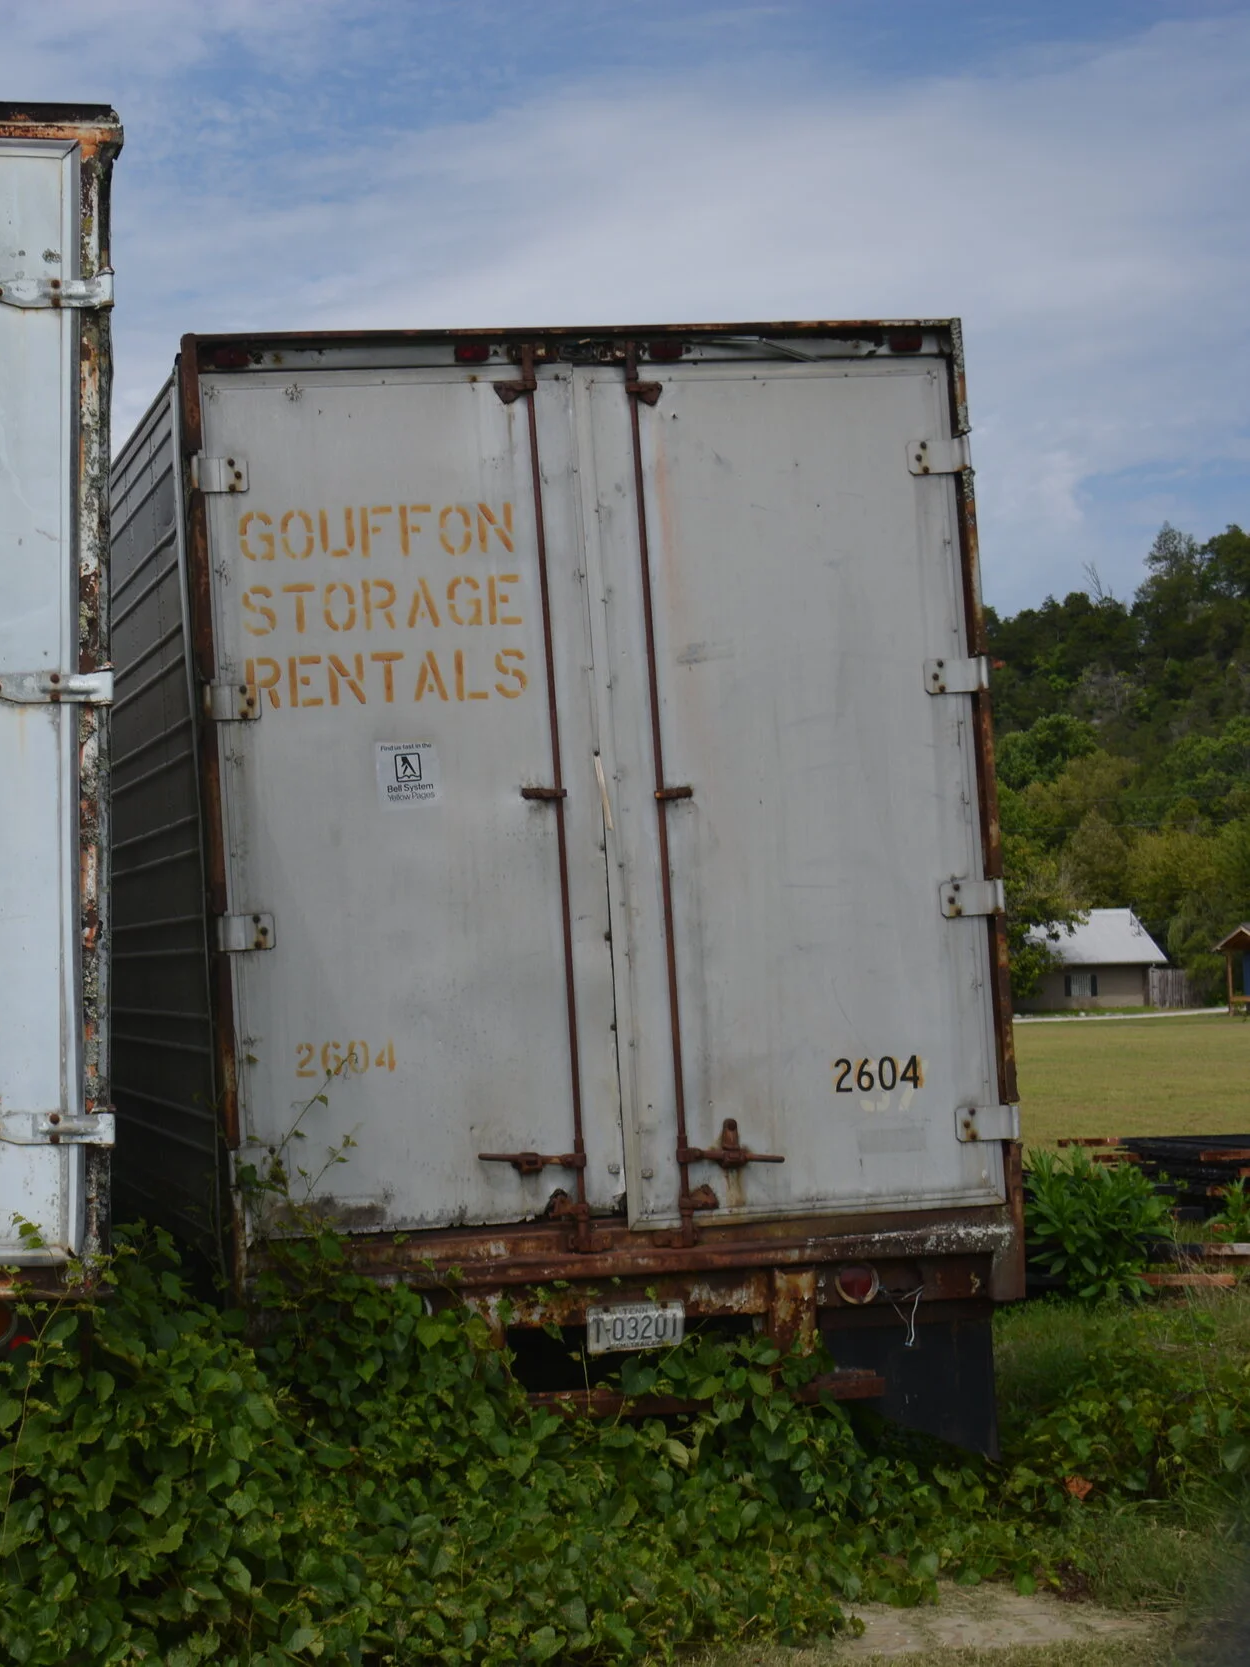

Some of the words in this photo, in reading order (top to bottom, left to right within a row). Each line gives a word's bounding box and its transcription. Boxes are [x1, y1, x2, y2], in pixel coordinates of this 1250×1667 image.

[238, 502, 514, 561] GOUFFON
[241, 574, 522, 636] STORAGE
[244, 649, 528, 709] RENTALS
[387, 784, 403, 793] Bell
[403, 783, 434, 792] System
[387, 793, 410, 801] Yellow
[411, 791, 436, 801] Pages
[295, 1038, 397, 1078] 2604
[834, 1055, 920, 1093] 2604
